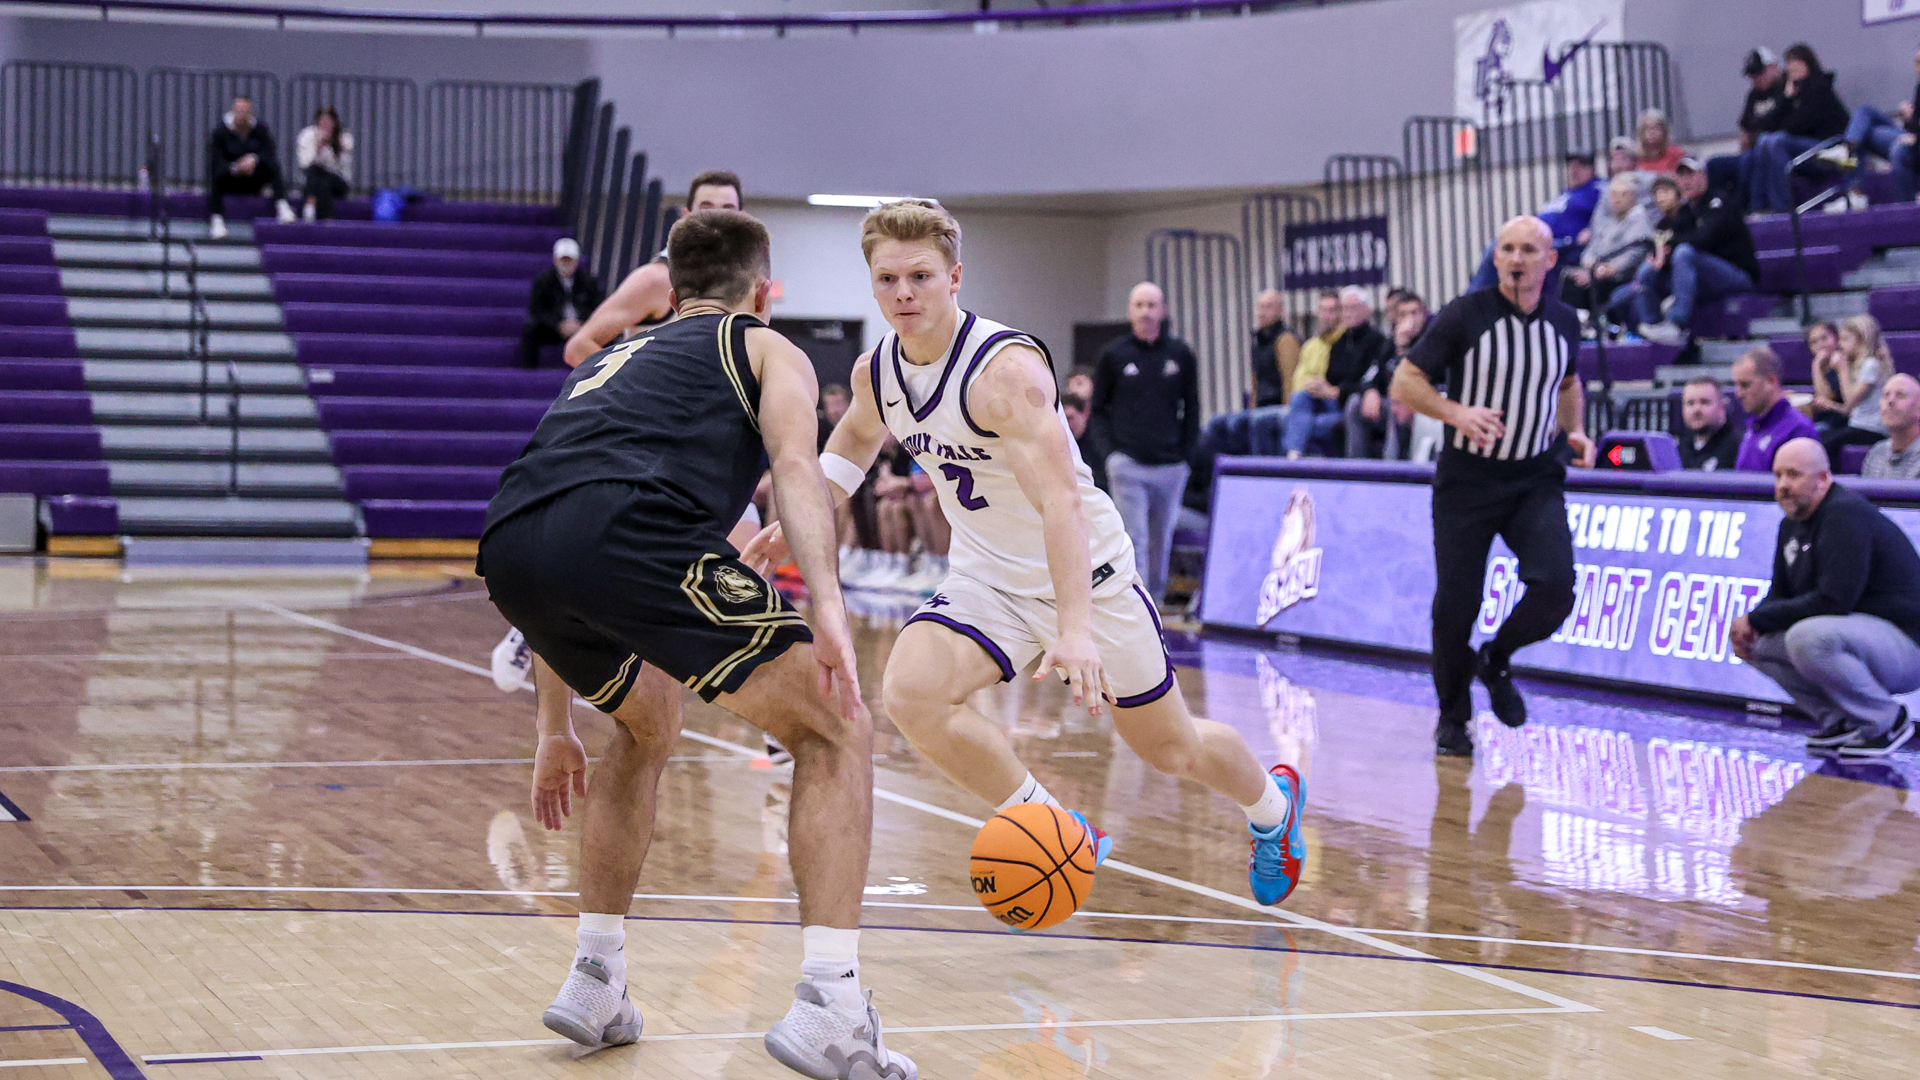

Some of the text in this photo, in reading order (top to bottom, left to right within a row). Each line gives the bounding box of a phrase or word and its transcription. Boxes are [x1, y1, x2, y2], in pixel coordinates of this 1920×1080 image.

[567, 336, 656, 400] 3
[938, 462, 990, 511] 2
[1567, 502, 1746, 559] ELCOME TO THE
[1649, 571, 1772, 665] CENT
